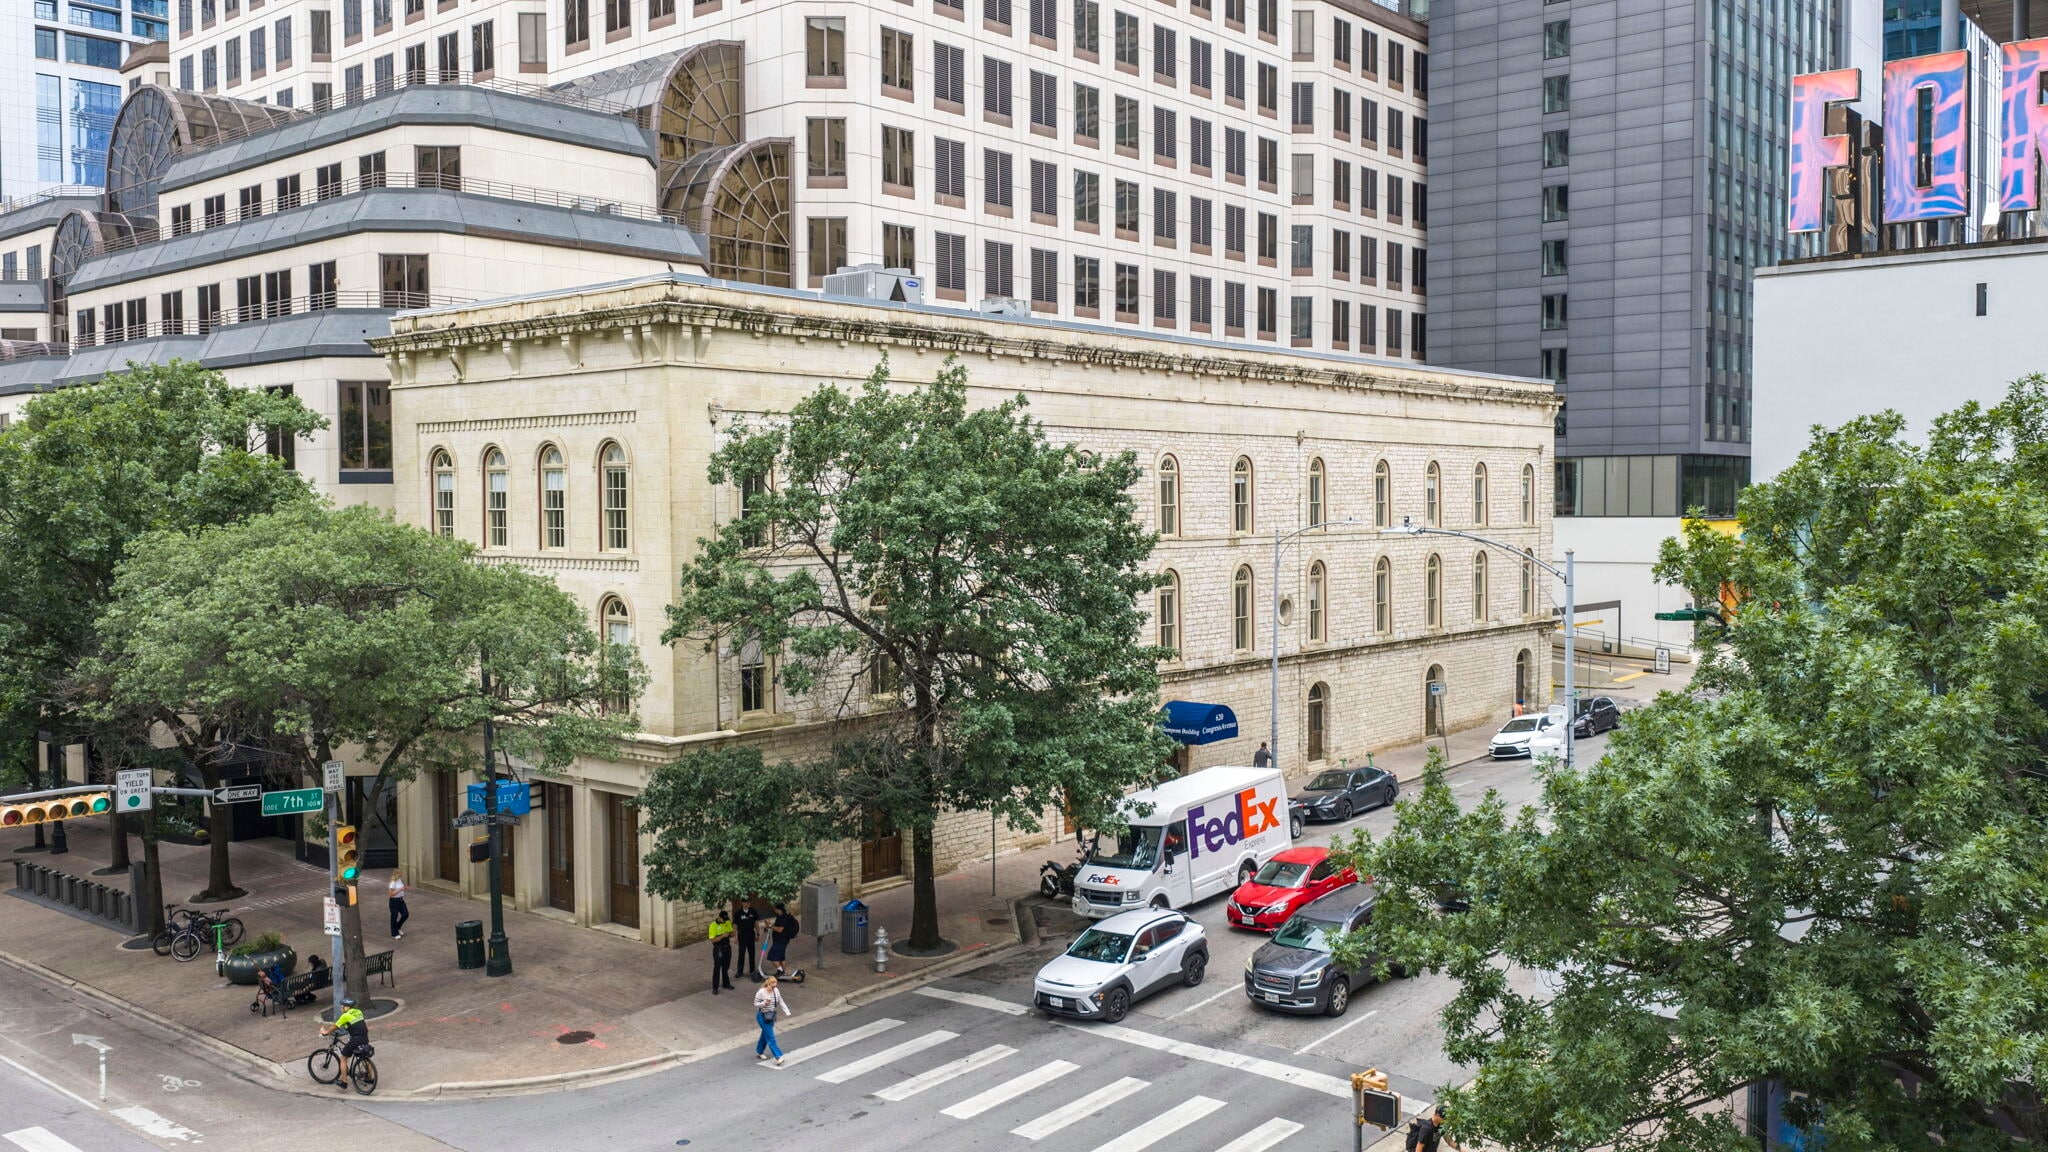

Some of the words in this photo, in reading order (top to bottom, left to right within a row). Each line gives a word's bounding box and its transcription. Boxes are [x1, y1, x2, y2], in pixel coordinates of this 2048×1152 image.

[1215, 713, 1224, 722] 620
[1202, 725, 1222, 735] Congress
[125, 779, 144, 788] YIELD
[227, 790, 240, 799] ONE
[242, 789, 257, 798] WAY
[498, 792, 523, 804] LEVY
[283, 796, 304, 809] 7th
[311, 792, 318, 800] ST
[1187, 787, 1281, 860] FedEx
[1244, 836, 1266, 850] Express
[1087, 873, 1120, 885] FedEx
